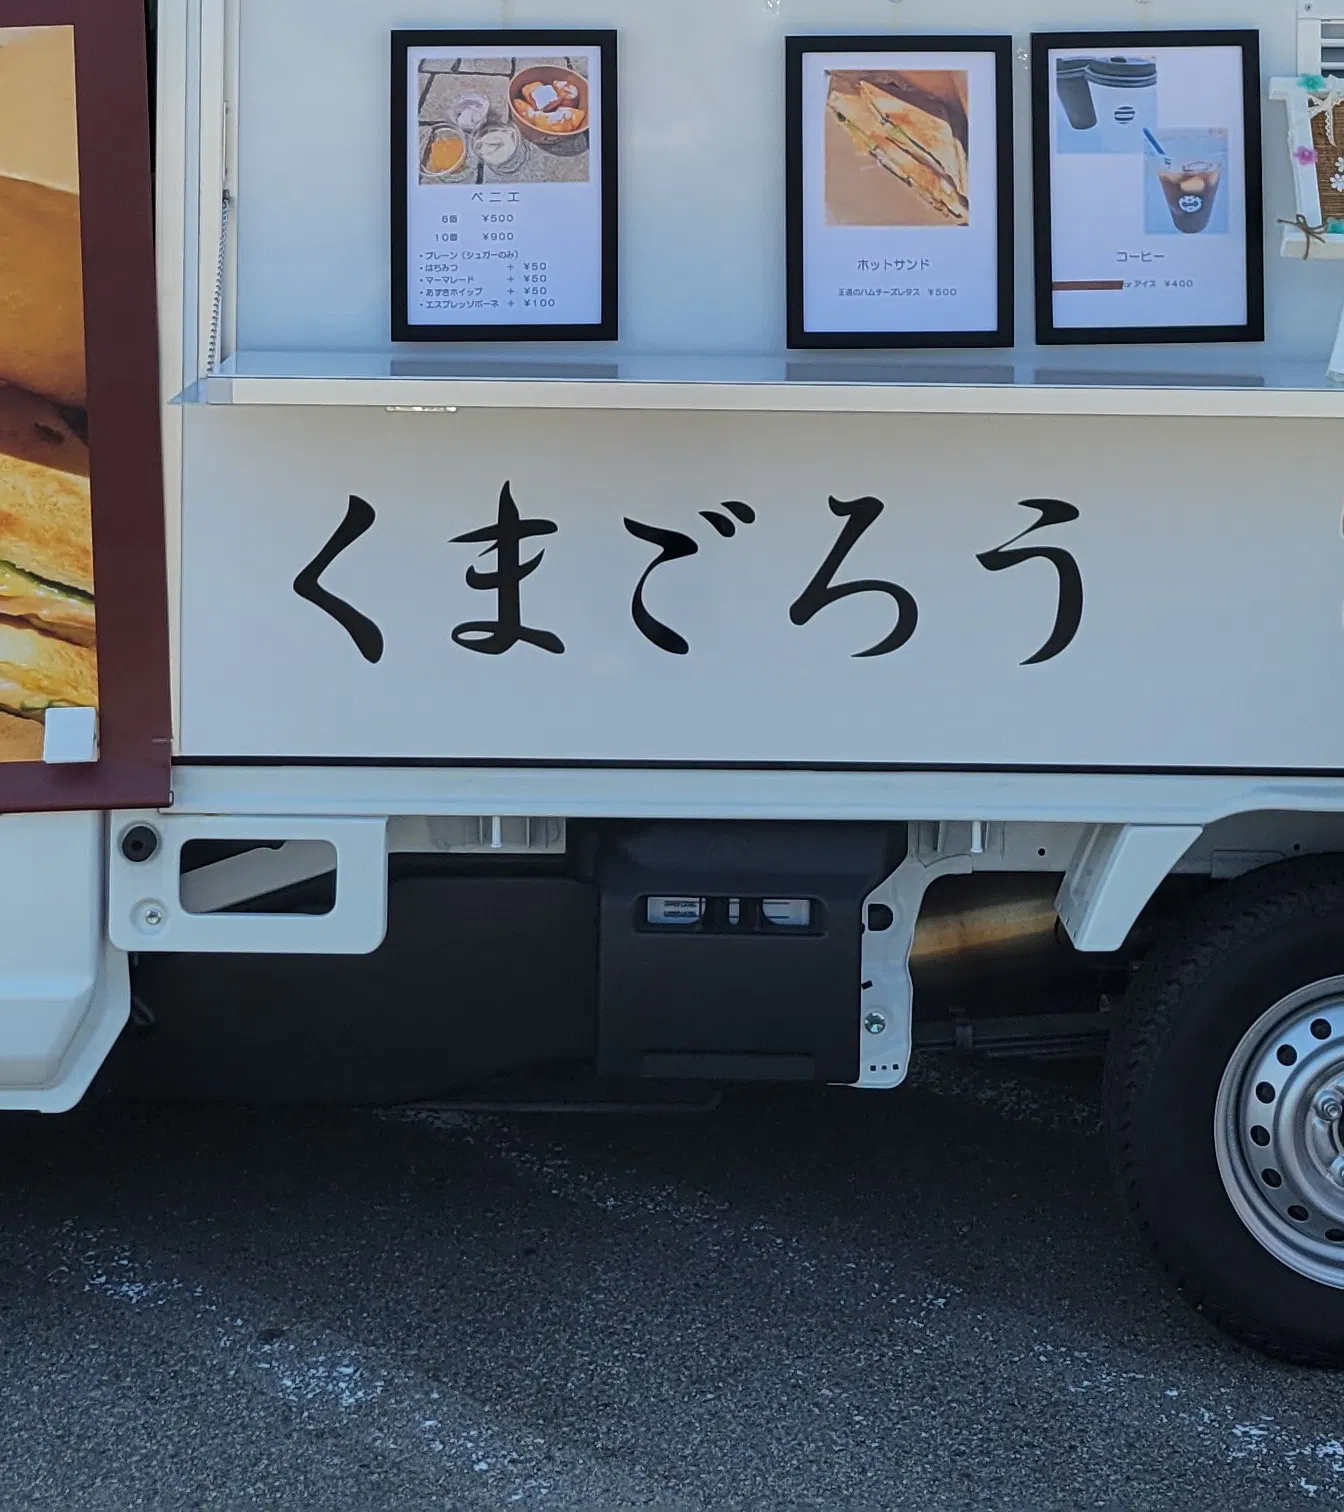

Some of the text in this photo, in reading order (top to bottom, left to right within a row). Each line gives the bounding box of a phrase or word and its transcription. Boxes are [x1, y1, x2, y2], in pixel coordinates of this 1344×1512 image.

[471, 191, 521, 203] ベニエ
[482, 213, 514, 223] ¥500
[483, 231, 514, 241] ¥900
[1116, 251, 1165, 262] コーヒー
[523, 262, 547, 271] ¥50
[857, 258, 930, 271] ホットサンド
[523, 274, 547, 283] ¥50
[1164, 279, 1193, 288] ¥400
[523, 286, 547, 295] ¥50
[927, 288, 957, 296] ¥500
[523, 299, 555, 308] ¥100
[292, 479, 1084, 666] くまごろう
